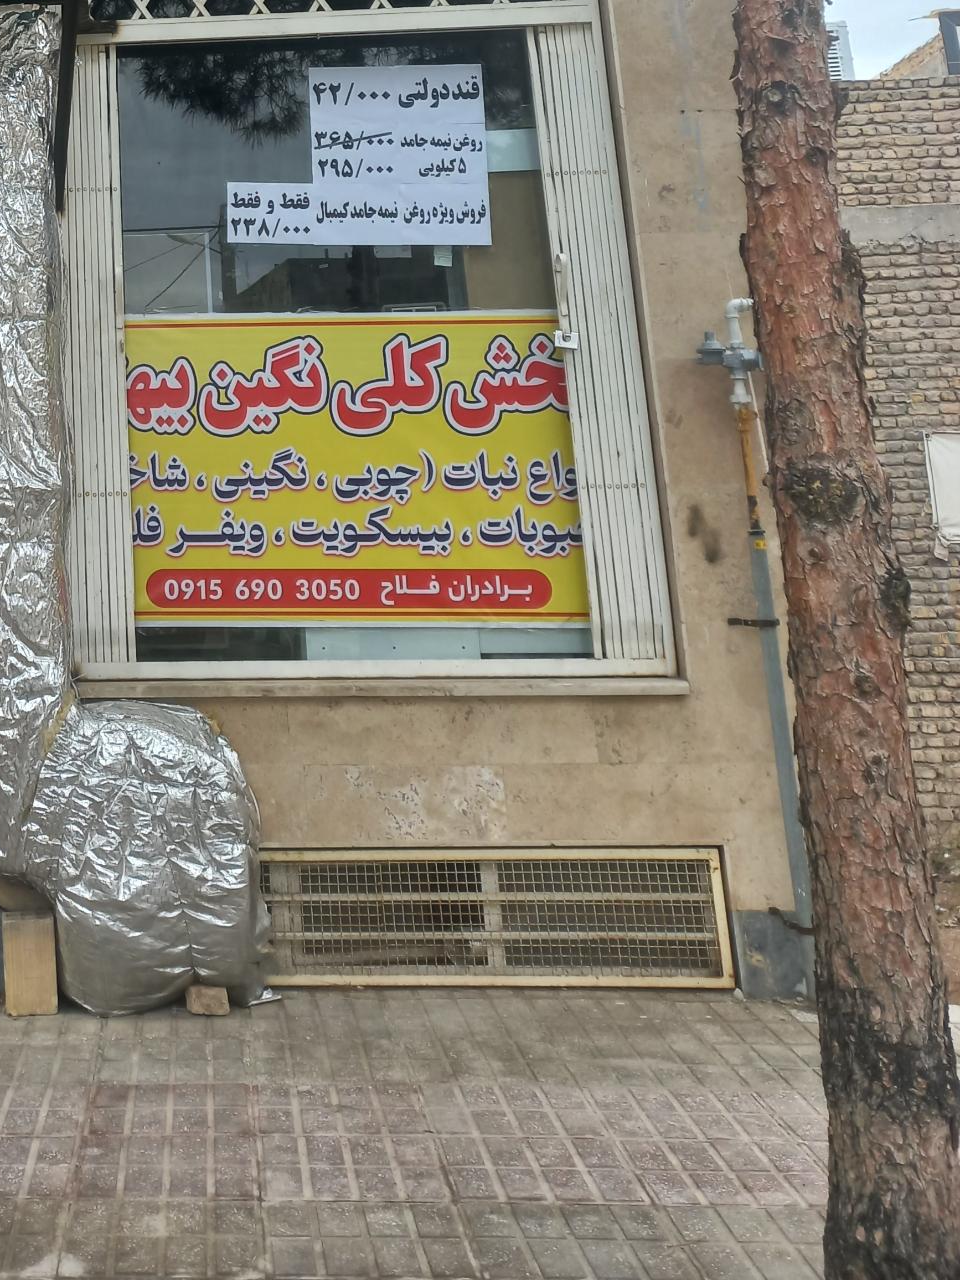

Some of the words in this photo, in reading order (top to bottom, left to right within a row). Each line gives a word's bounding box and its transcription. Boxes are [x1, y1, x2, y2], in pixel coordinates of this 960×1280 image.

[312, 81, 391, 106] ۴۲/۰۰۰
[313, 130, 394, 151] ۳۶۵/۰۰۰
[400, 133, 428, 151] جامد
[429, 133, 452, 151] نیمه
[452, 134, 483, 152] روغن
[317, 158, 394, 178] ۲۹۵/۰۰۰
[418, 158, 456, 177] کیلویی
[457, 157, 467, 174] ۵
[230, 191, 261, 209] فقط
[265, 199, 275, 215] و
[280, 191, 310, 210] فقط
[350, 201, 377, 223] جامد
[377, 201, 398, 223] نیمه
[403, 201, 431, 224] روغن
[432, 202, 455, 224] ویژه
[456, 199, 487, 224] فروش
[230, 217, 311, 238] ۲۳۸/۰۰۰
[126, 358, 194, 432] بیه
[200, 338, 326, 434] نگین
[333, 336, 444, 433] کلی
[447, 337, 570, 432] خش
[129, 453, 187, 488] شاخ
[443, 450, 518, 497] نبات
[529, 451, 578, 501] واع
[132, 506, 162, 544] فل
[167, 510, 266, 554] ویفر
[164, 579, 223, 601] 0915
[235, 579, 283, 601] 690
[295, 579, 360, 601] 3050
[380, 575, 440, 606] فلاح
[448, 575, 533, 602] برادران
